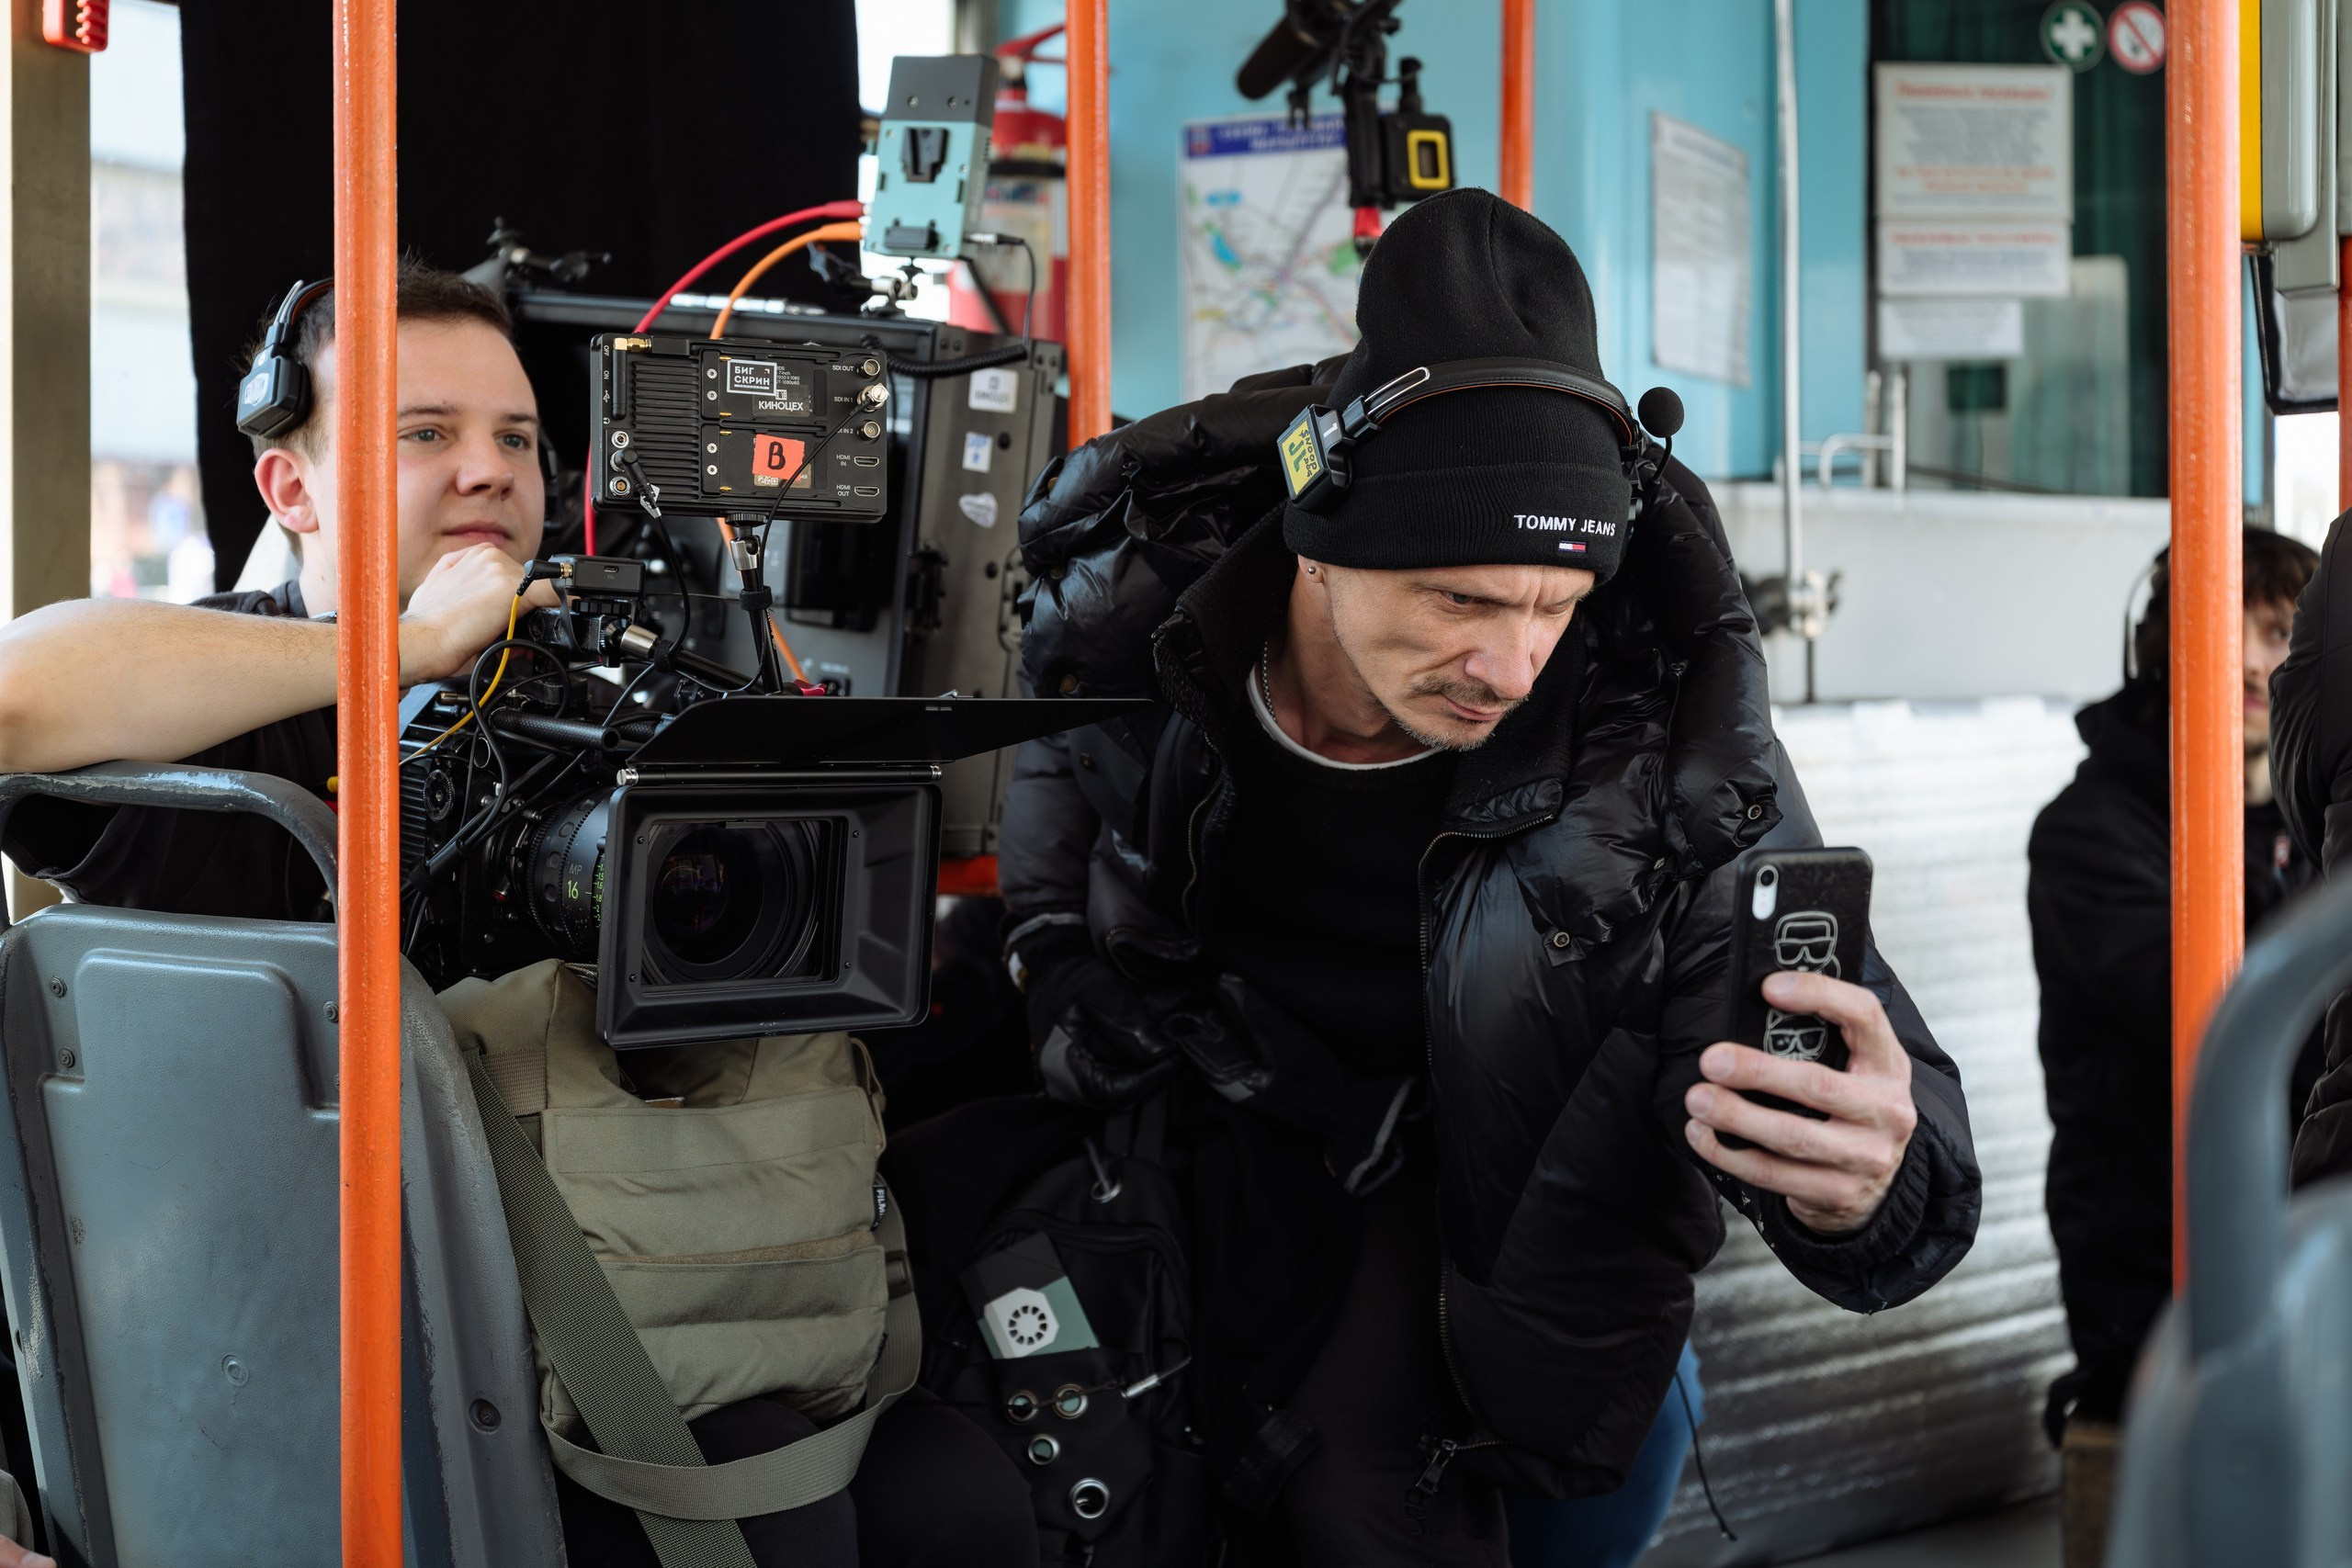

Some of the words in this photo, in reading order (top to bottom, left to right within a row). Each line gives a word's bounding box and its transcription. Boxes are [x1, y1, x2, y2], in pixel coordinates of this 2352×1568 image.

[604, 370, 610, 379] ON
[734, 366, 754, 376] БИГ
[734, 375, 770, 386] СКРИН
[758, 400, 804, 412] КИНОЦЕХ
[767, 441, 786, 469] B
[1513, 514, 1577, 531] TOMMY
[1580, 519, 1616, 536] JEANS
[567, 880, 579, 899] 16
